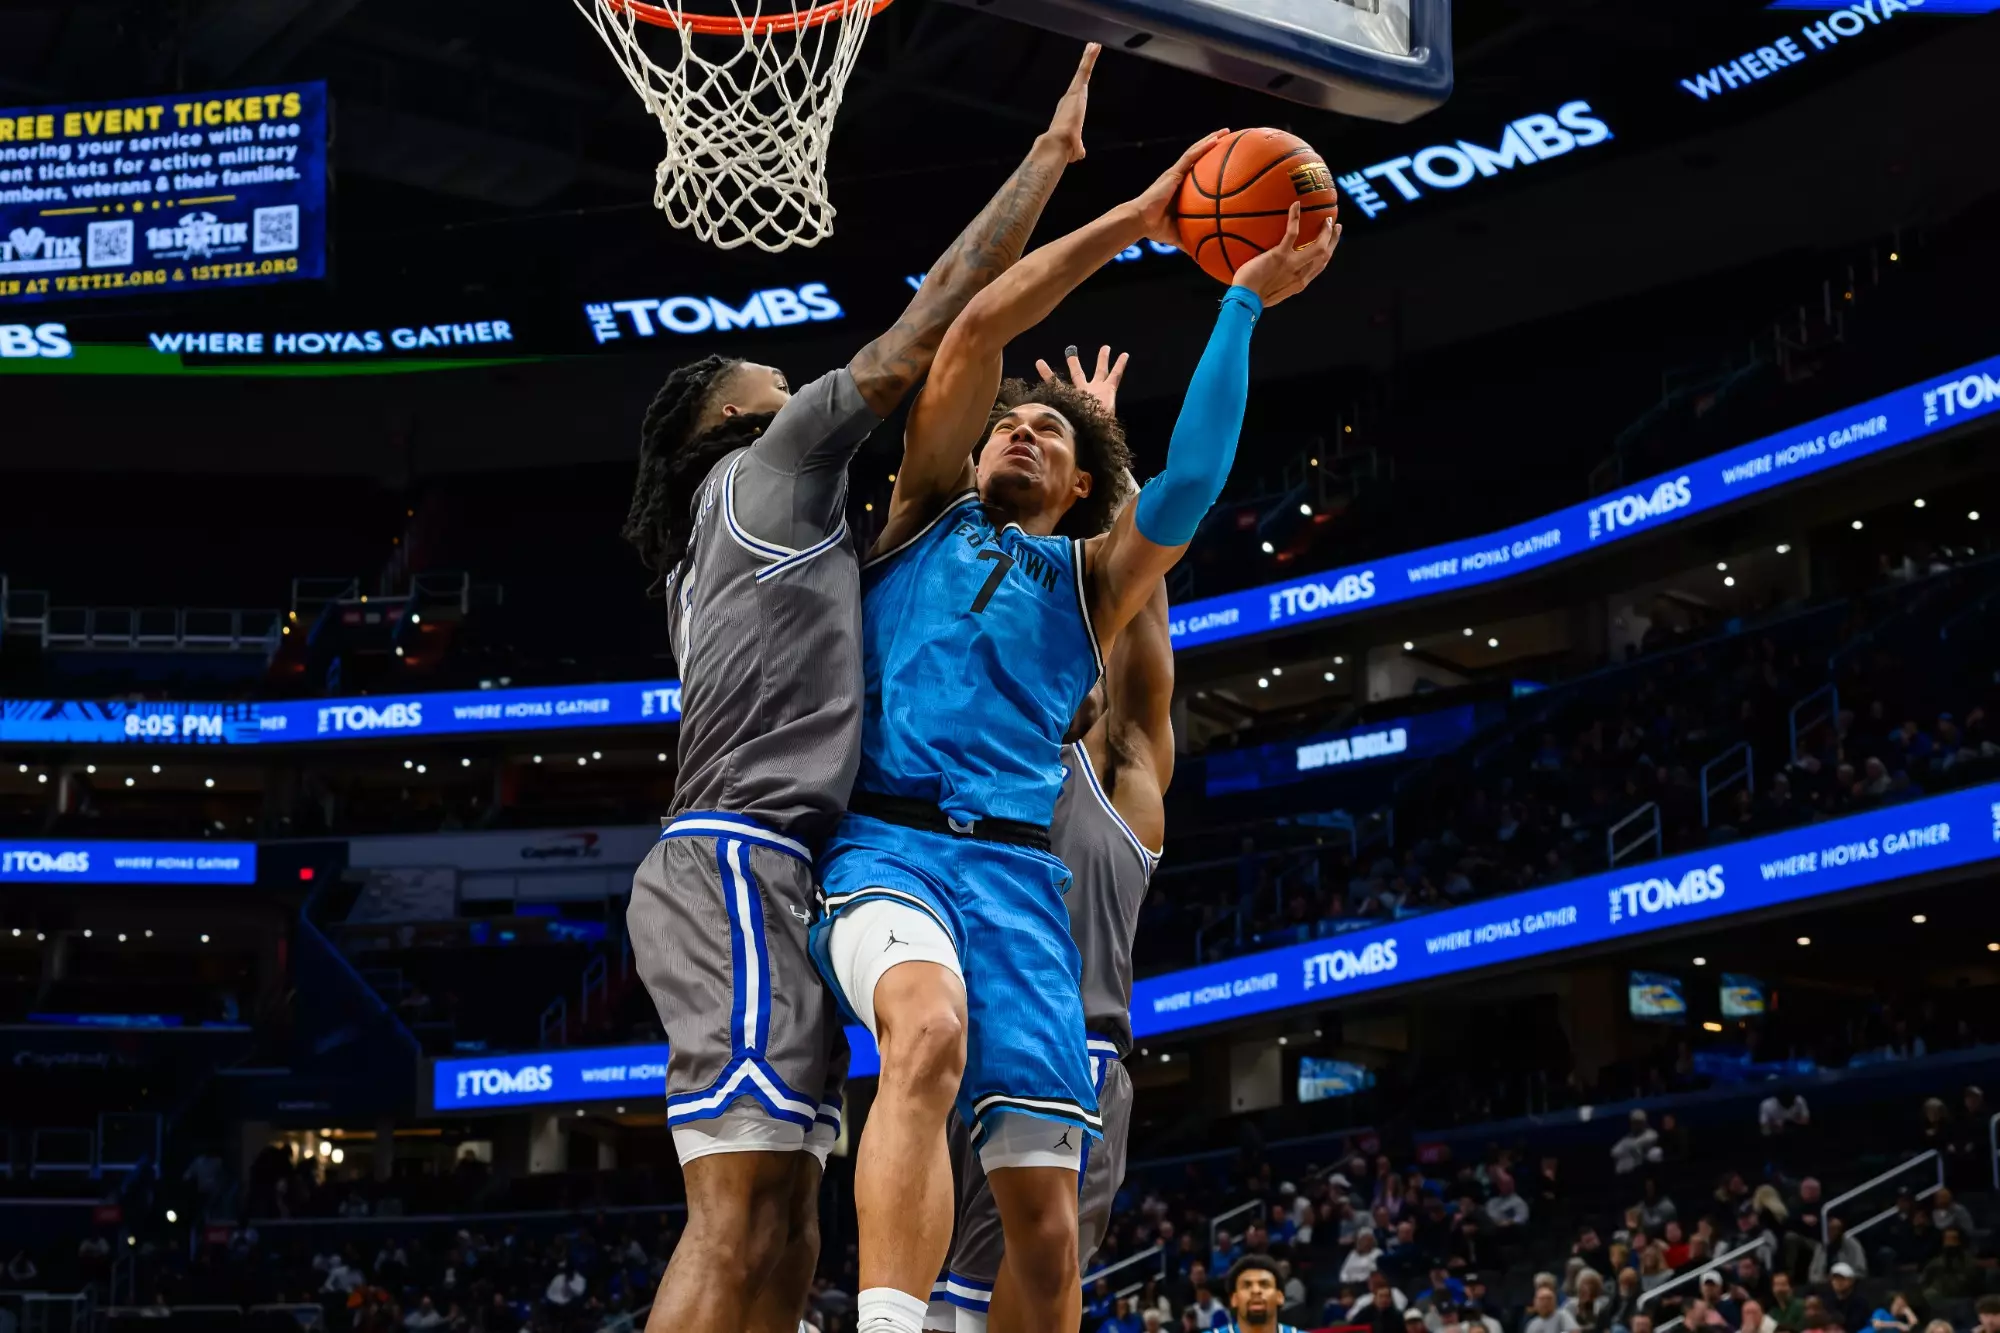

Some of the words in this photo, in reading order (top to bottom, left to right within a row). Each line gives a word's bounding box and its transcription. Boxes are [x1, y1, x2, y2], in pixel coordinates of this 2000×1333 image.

[1681, 35, 1806, 100] WHERE
[1803, 0, 1926, 50] HOYA
[64, 106, 164, 137] EVENT
[174, 92, 301, 128] TICKETS
[77, 140, 124, 160] your
[129, 132, 203, 152] service
[208, 125, 253, 145] with
[259, 122, 301, 140] free
[1337, 170, 1388, 219] THE
[1363, 101, 1609, 200] TOMBS
[39, 161, 108, 181] tickets
[113, 157, 144, 175] for
[150, 152, 212, 172] active
[218, 145, 298, 166] military
[72, 181, 151, 198] veterans
[173, 172, 218, 191] their
[222, 165, 301, 186] families.
[25, 279, 49, 294] AT
[55, 269, 167, 292] VETTIX.ORG
[192, 258, 297, 280] 1STTIX.ORG
[585, 303, 621, 343] THE
[613, 284, 840, 336] TOMBS
[149, 332, 263, 353] WHERE
[274, 331, 383, 353] HOYAS
[391, 320, 513, 349] GATHER
[1721, 458, 1772, 485] WHERE
[1775, 436, 1825, 467] HOYAS
[1828, 415, 1888, 450] GATHER
[1599, 475, 1692, 532] TOMBS
[1407, 557, 1458, 583] WHERE
[1461, 545, 1511, 572] HOYAS
[1511, 528, 1562, 557] GATHER
[970, 548, 1016, 614] 7
[1282, 570, 1376, 616] TOMBS
[1188, 608, 1239, 633] GATHER
[124, 714, 175, 737] 8:05
[183, 714, 222, 737] PM
[330, 702, 422, 731] TOMBS
[454, 704, 500, 720] WHERE
[505, 702, 552, 718] HOYAS
[555, 698, 610, 715] GATHER
[12, 851, 89, 873] TOMBS
[1760, 851, 1817, 881] WHERE
[1821, 838, 1879, 869] HOYAS
[1882, 822, 1950, 855] GATHER
[1621, 864, 1725, 917] TOMBS
[1426, 928, 1472, 955] WHERE
[1475, 917, 1520, 943] HOYAS
[1523, 905, 1577, 935] GATHER
[1313, 938, 1398, 984] TOMBS
[1153, 987, 1190, 1013] WHERE
[1234, 972, 1278, 998] GATHER
[467, 1065, 552, 1096] TOMBS
[581, 1066, 626, 1082] WHERE
